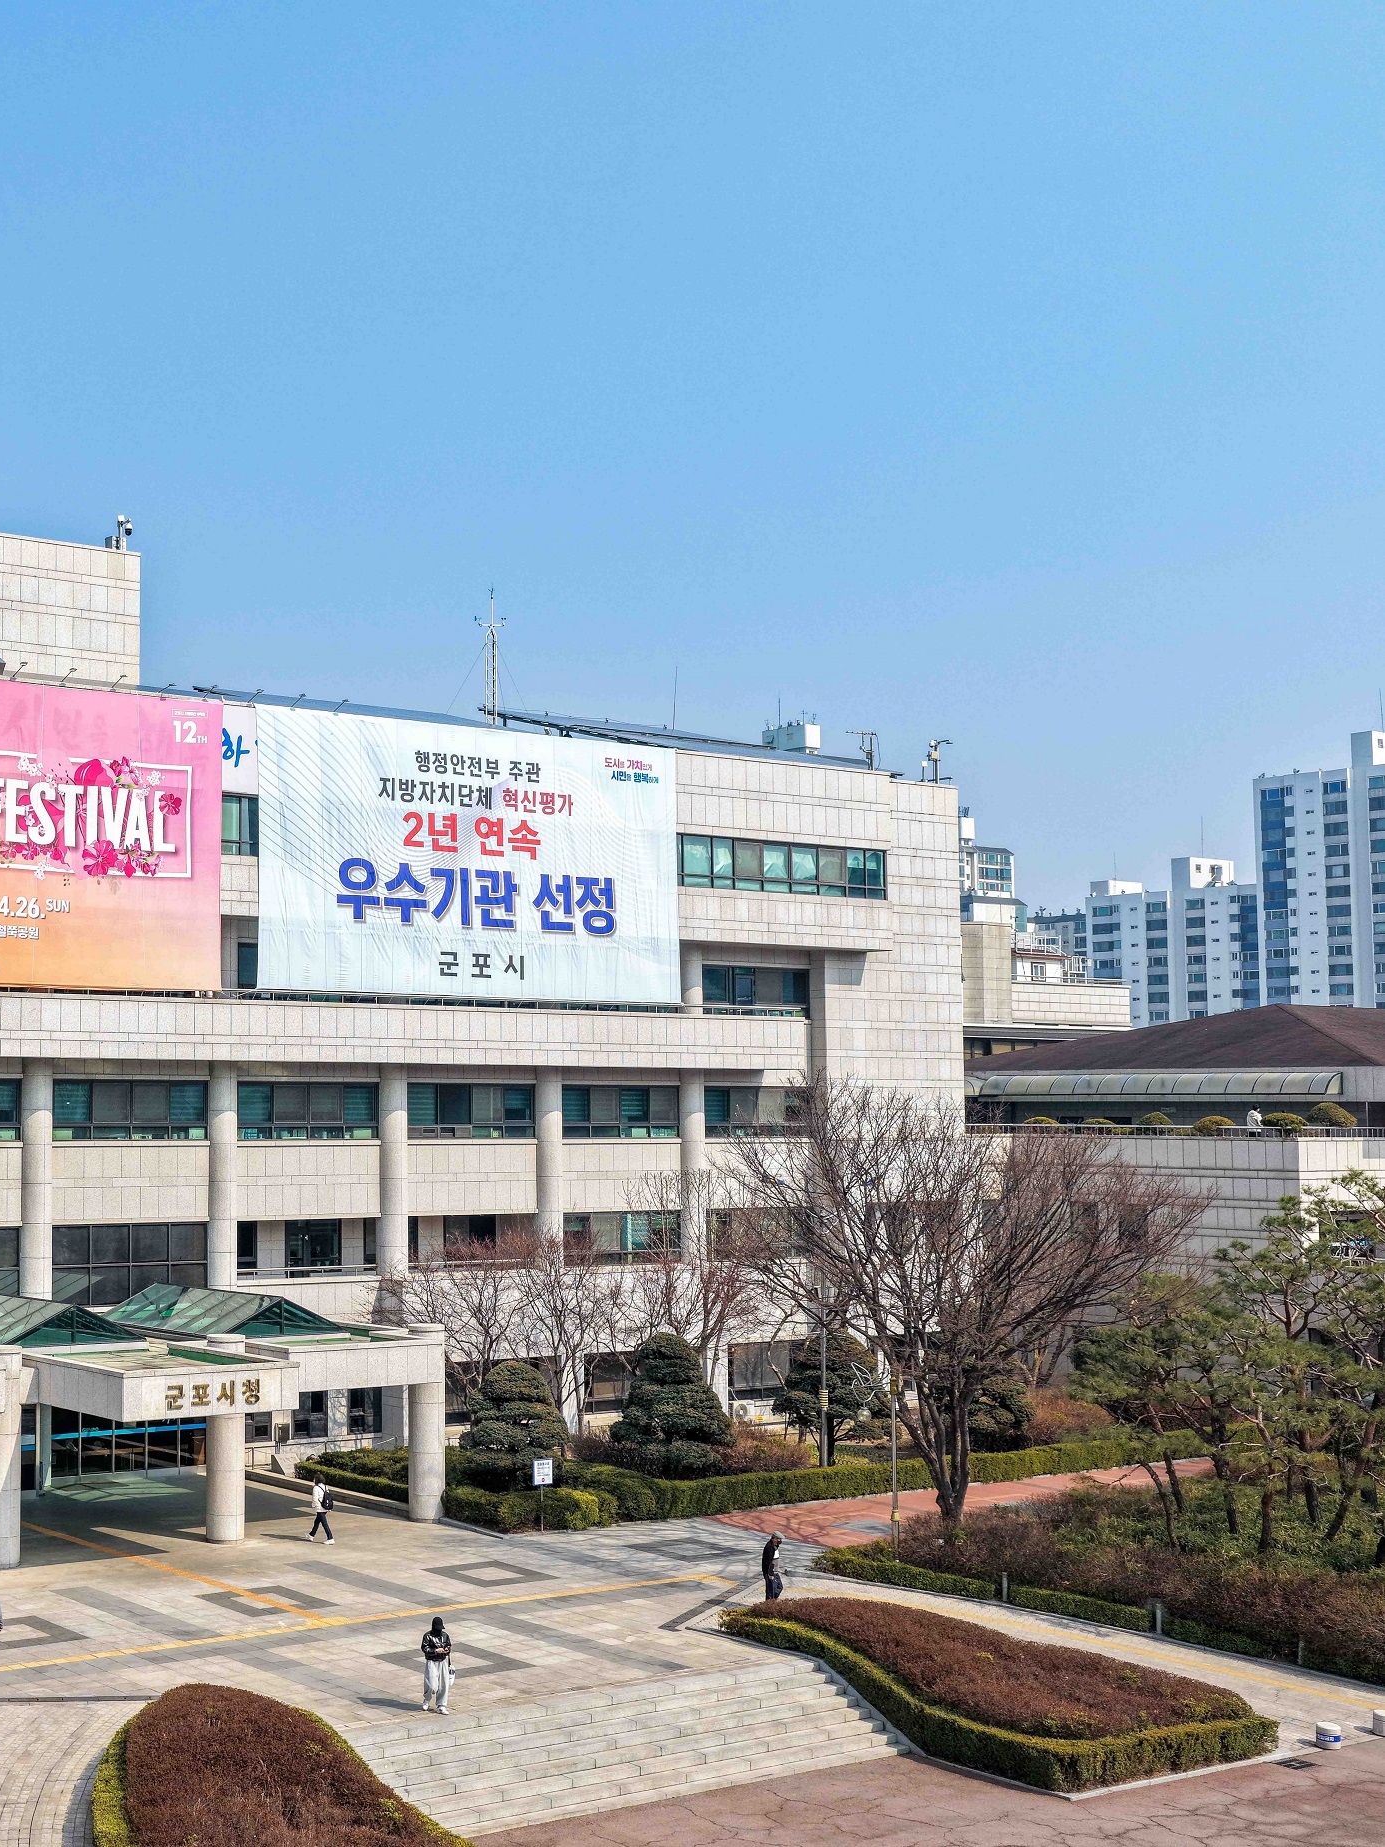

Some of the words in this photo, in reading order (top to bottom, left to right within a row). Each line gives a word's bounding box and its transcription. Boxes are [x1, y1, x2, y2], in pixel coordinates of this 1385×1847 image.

[414, 750, 501, 780] 행정안전부
[508, 760, 541, 784] 주관
[611, 770, 632, 781] 시민을
[633, 772, 659, 784] 행복하게
[378, 777, 493, 810] 지방자치단체
[502, 787, 573, 816] 혁신평가
[402, 811, 459, 853] 2년
[474, 816, 541, 860] 연속
[336, 857, 519, 930] 우수기관
[532, 873, 616, 936] 선정
[165, 1379, 261, 1411] 군포시청
